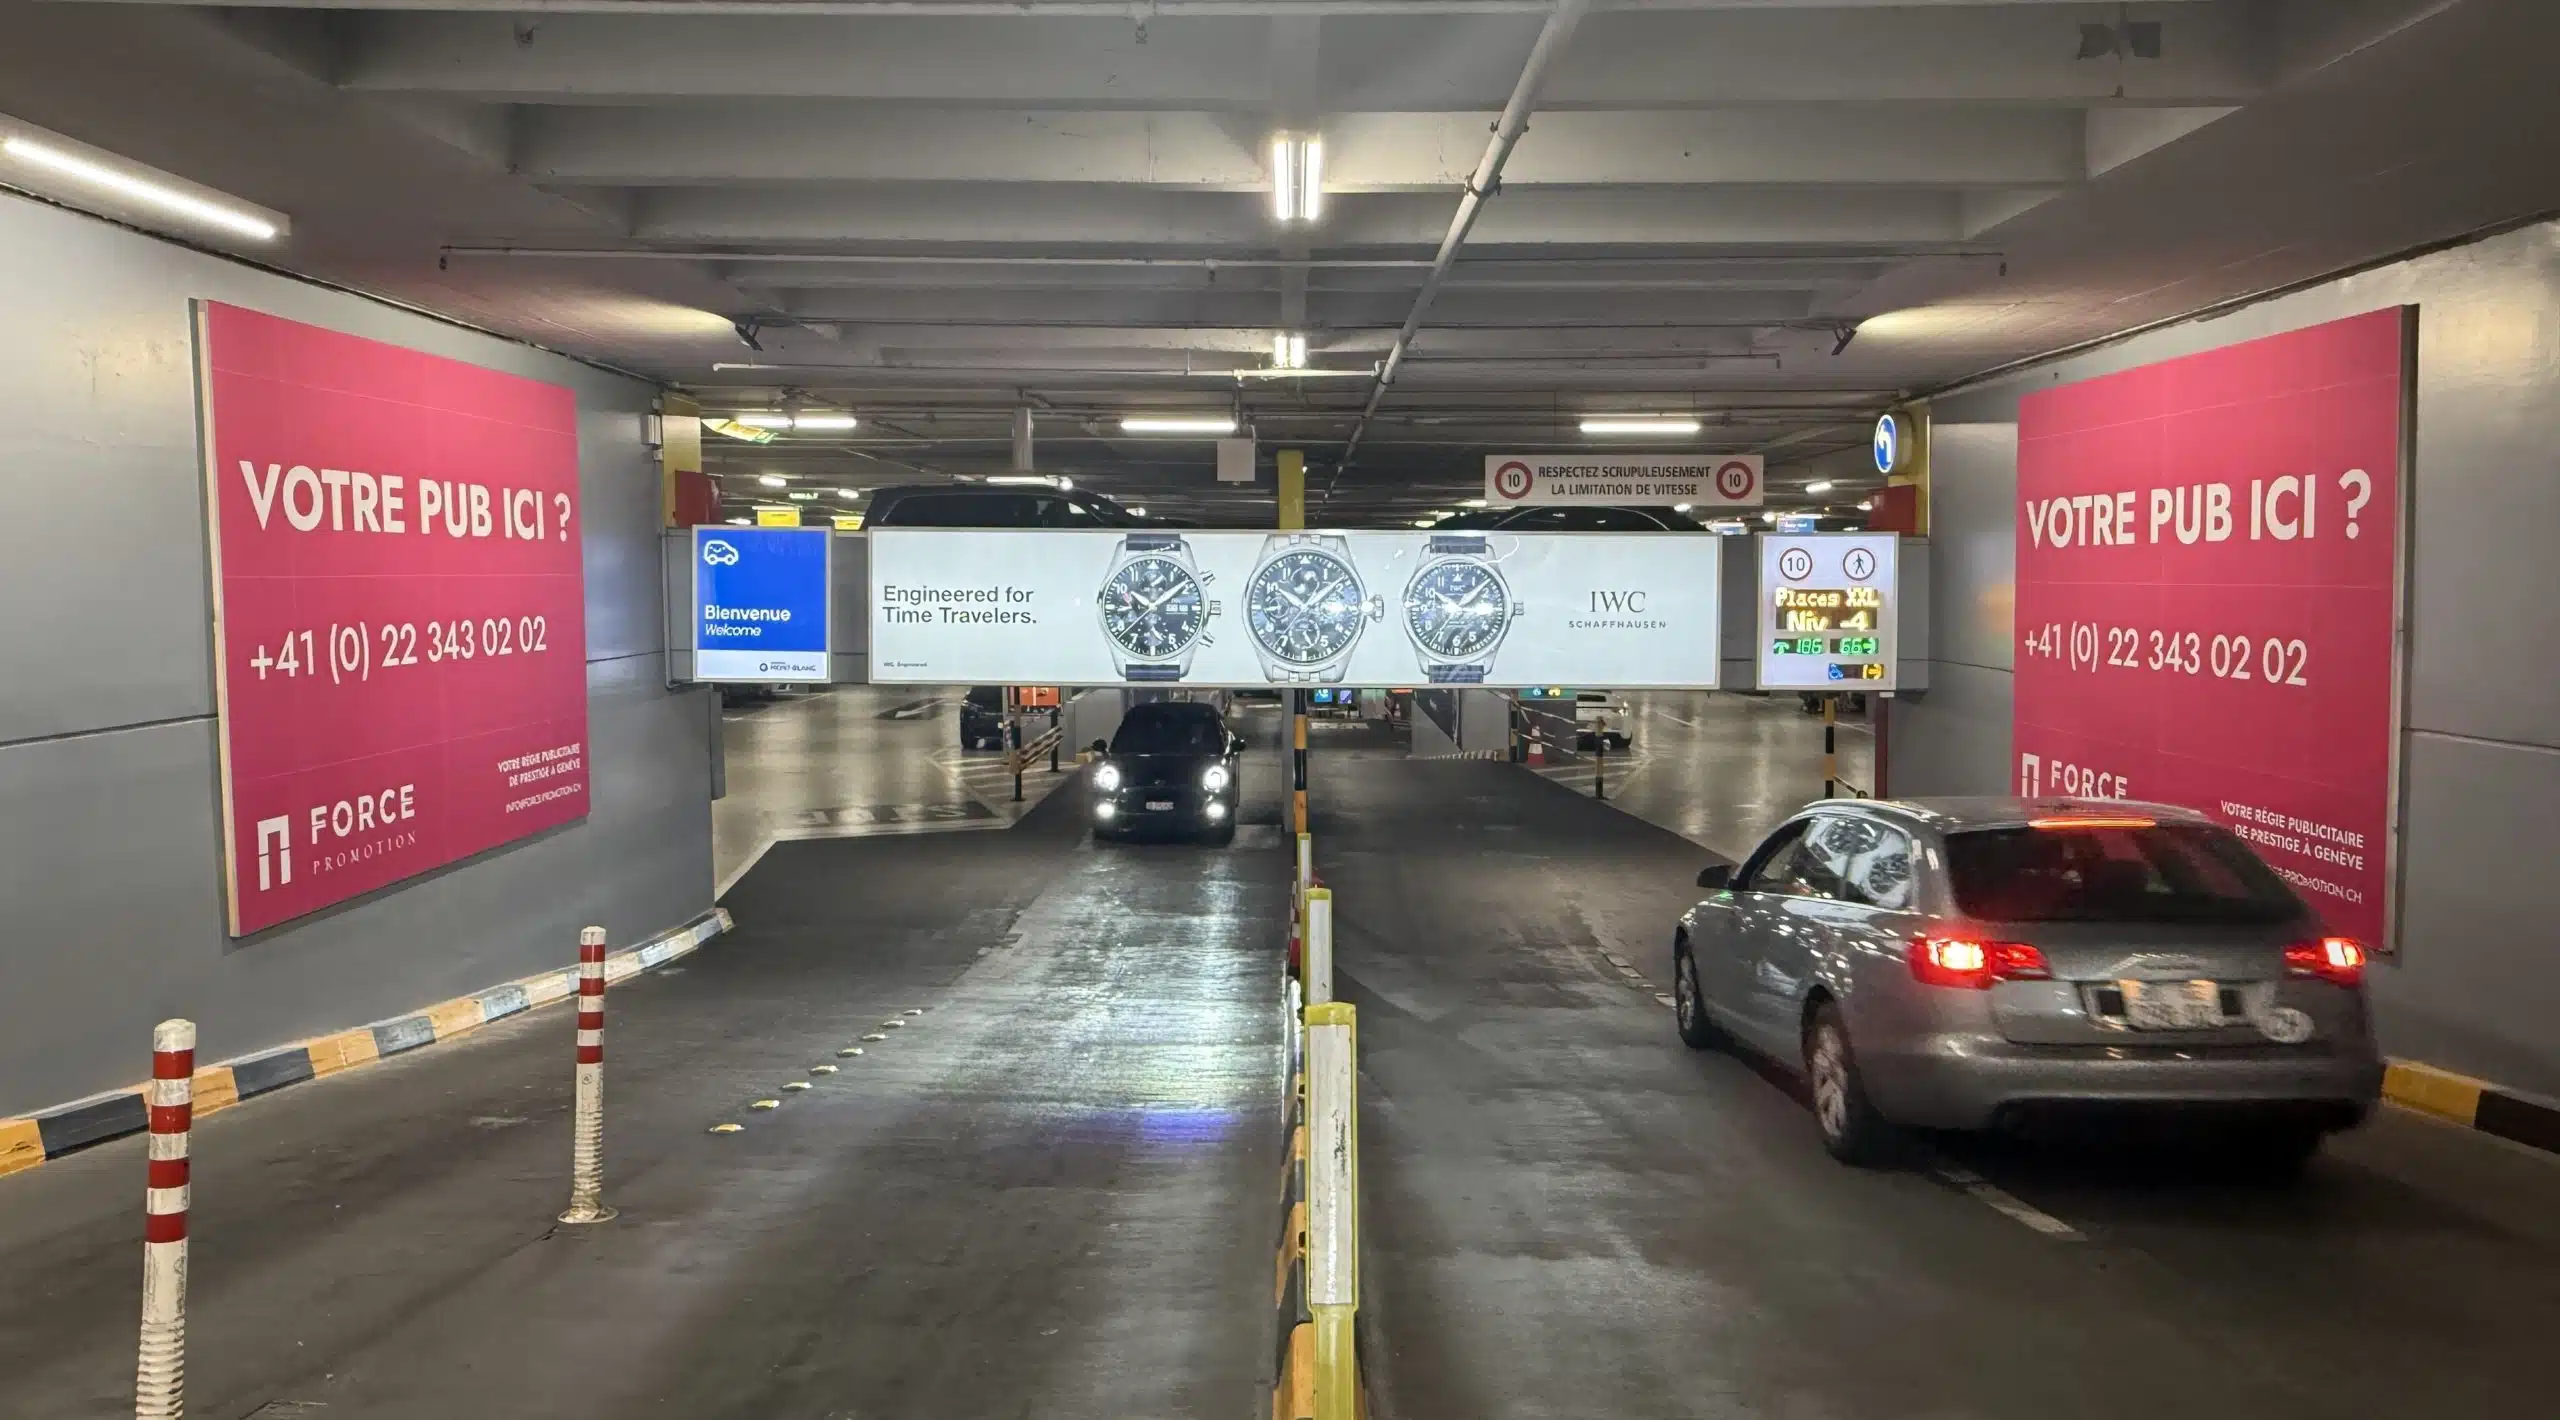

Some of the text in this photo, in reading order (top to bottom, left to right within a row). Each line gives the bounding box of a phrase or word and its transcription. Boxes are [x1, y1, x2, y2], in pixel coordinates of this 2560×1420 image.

[1507, 474, 1521, 488] 10
[1538, 466, 1712, 478] RESPECTEZ SCRUPULEUSEMENT
[1728, 474, 1741, 488] 10
[1551, 484, 1698, 496] LA LIMITATION DE VITESSE
[240, 460, 571, 542] VOTRE PUB ICI ?
[2026, 469, 2371, 549] VOTRE PUB ICI ?
[1786, 557, 1806, 572] 10
[884, 585, 1034, 605] Engineered for
[1590, 590, 1646, 613] IWC
[1775, 586, 1880, 607] Places XXL
[704, 605, 791, 622] Bienvenue
[882, 606, 1038, 624] Time Travelers.
[1786, 610, 1869, 632] Niv -4
[705, 623, 762, 637] Welcome
[1568, 620, 1667, 629] SCHAFFHAUSEN
[251, 616, 547, 685] +41 (0) 22 343 02 02
[2025, 621, 2308, 687] +41 (0) 22 343 02 02
[497, 757, 520, 773] VOTRE
[509, 774, 519, 788] DE
[2051, 759, 2128, 800] FORCE
[311, 783, 415, 845] FORCE
[2221, 799, 2365, 849] VOTRE RÉGIE PUBLICITAIRE
[312, 829, 418, 876] PROMOTION
[2234, 823, 2364, 871] DE PRESTIGE À GENÈVE
